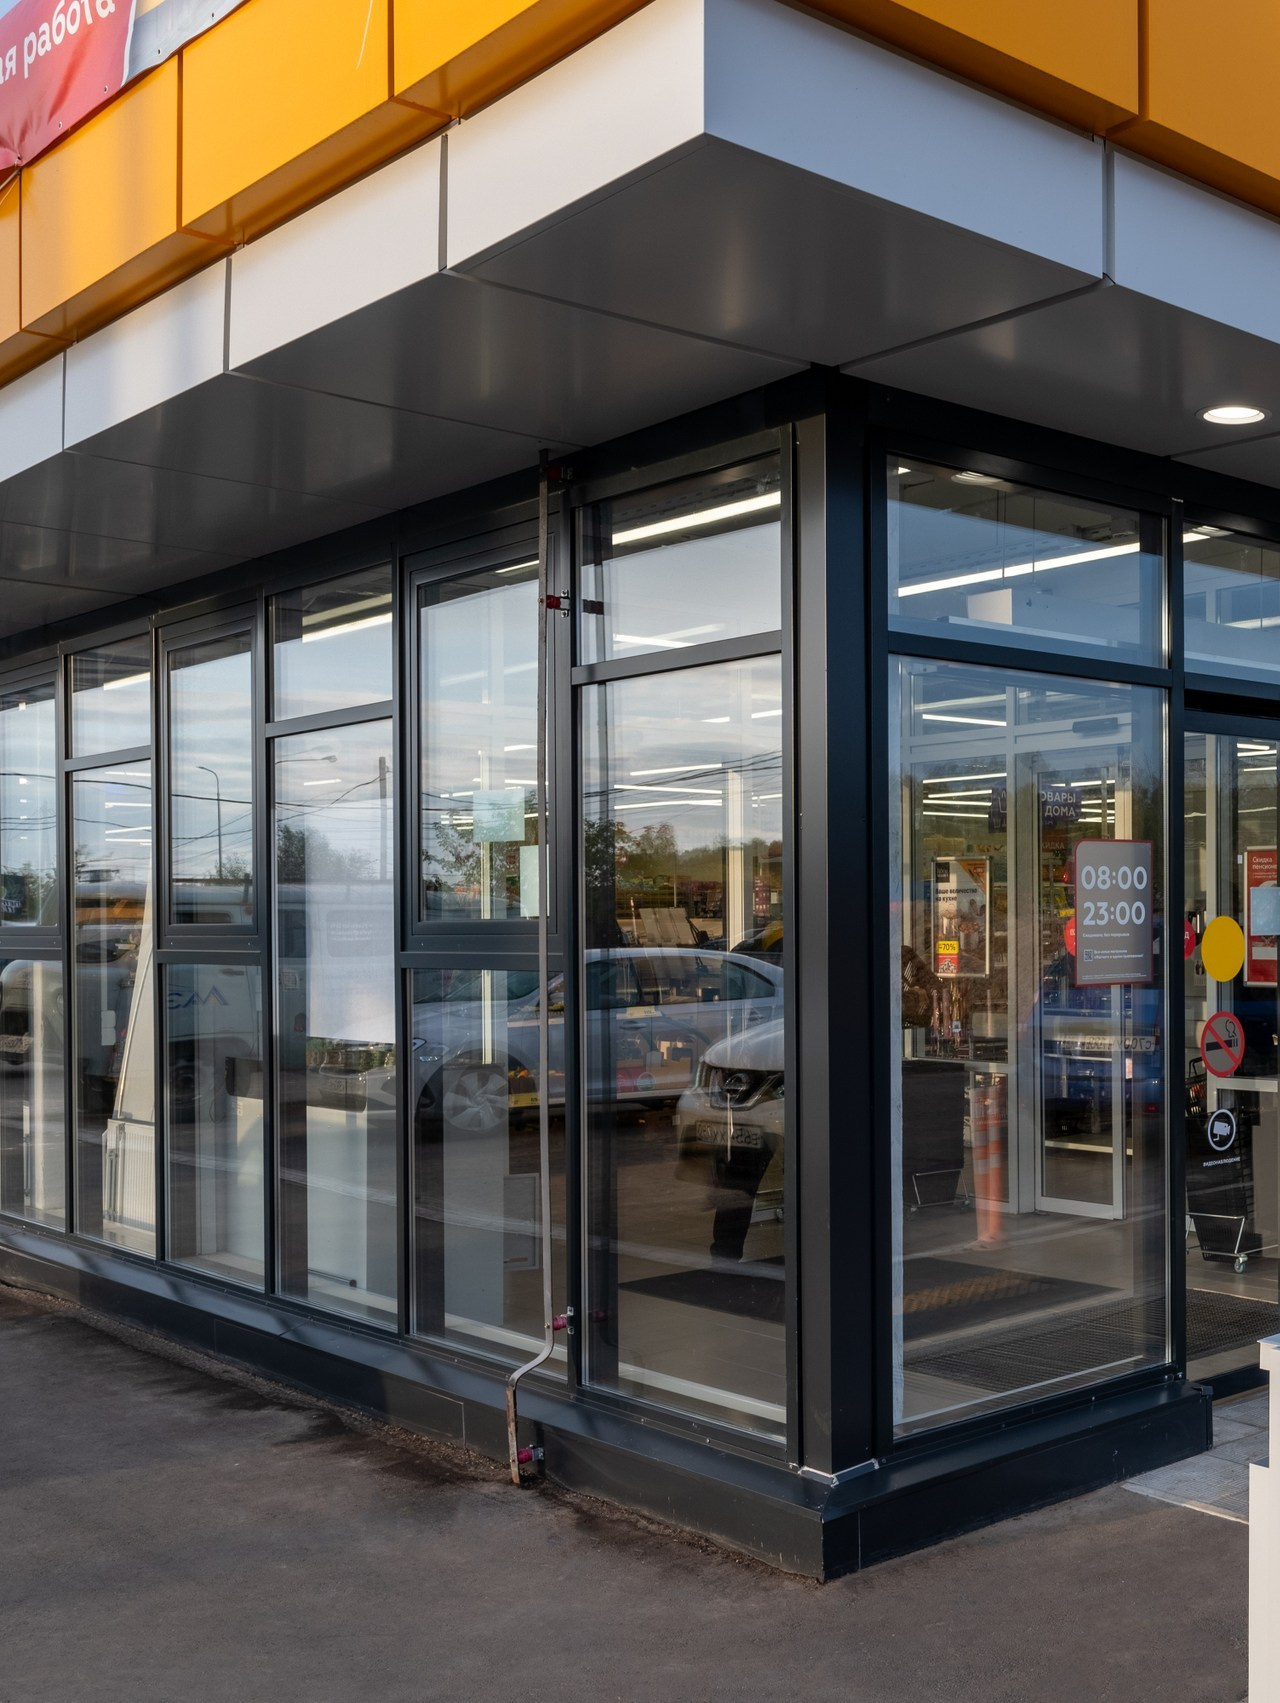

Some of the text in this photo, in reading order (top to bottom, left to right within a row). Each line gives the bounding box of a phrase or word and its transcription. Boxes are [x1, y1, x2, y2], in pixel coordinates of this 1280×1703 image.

[24, 0, 115, 79] работа
[1045, 806, 1076, 817] ДОМА
[1252, 856, 1272, 864] Скидка
[1081, 865, 1148, 890] 08:00
[1083, 901, 1146, 926] 23:00
